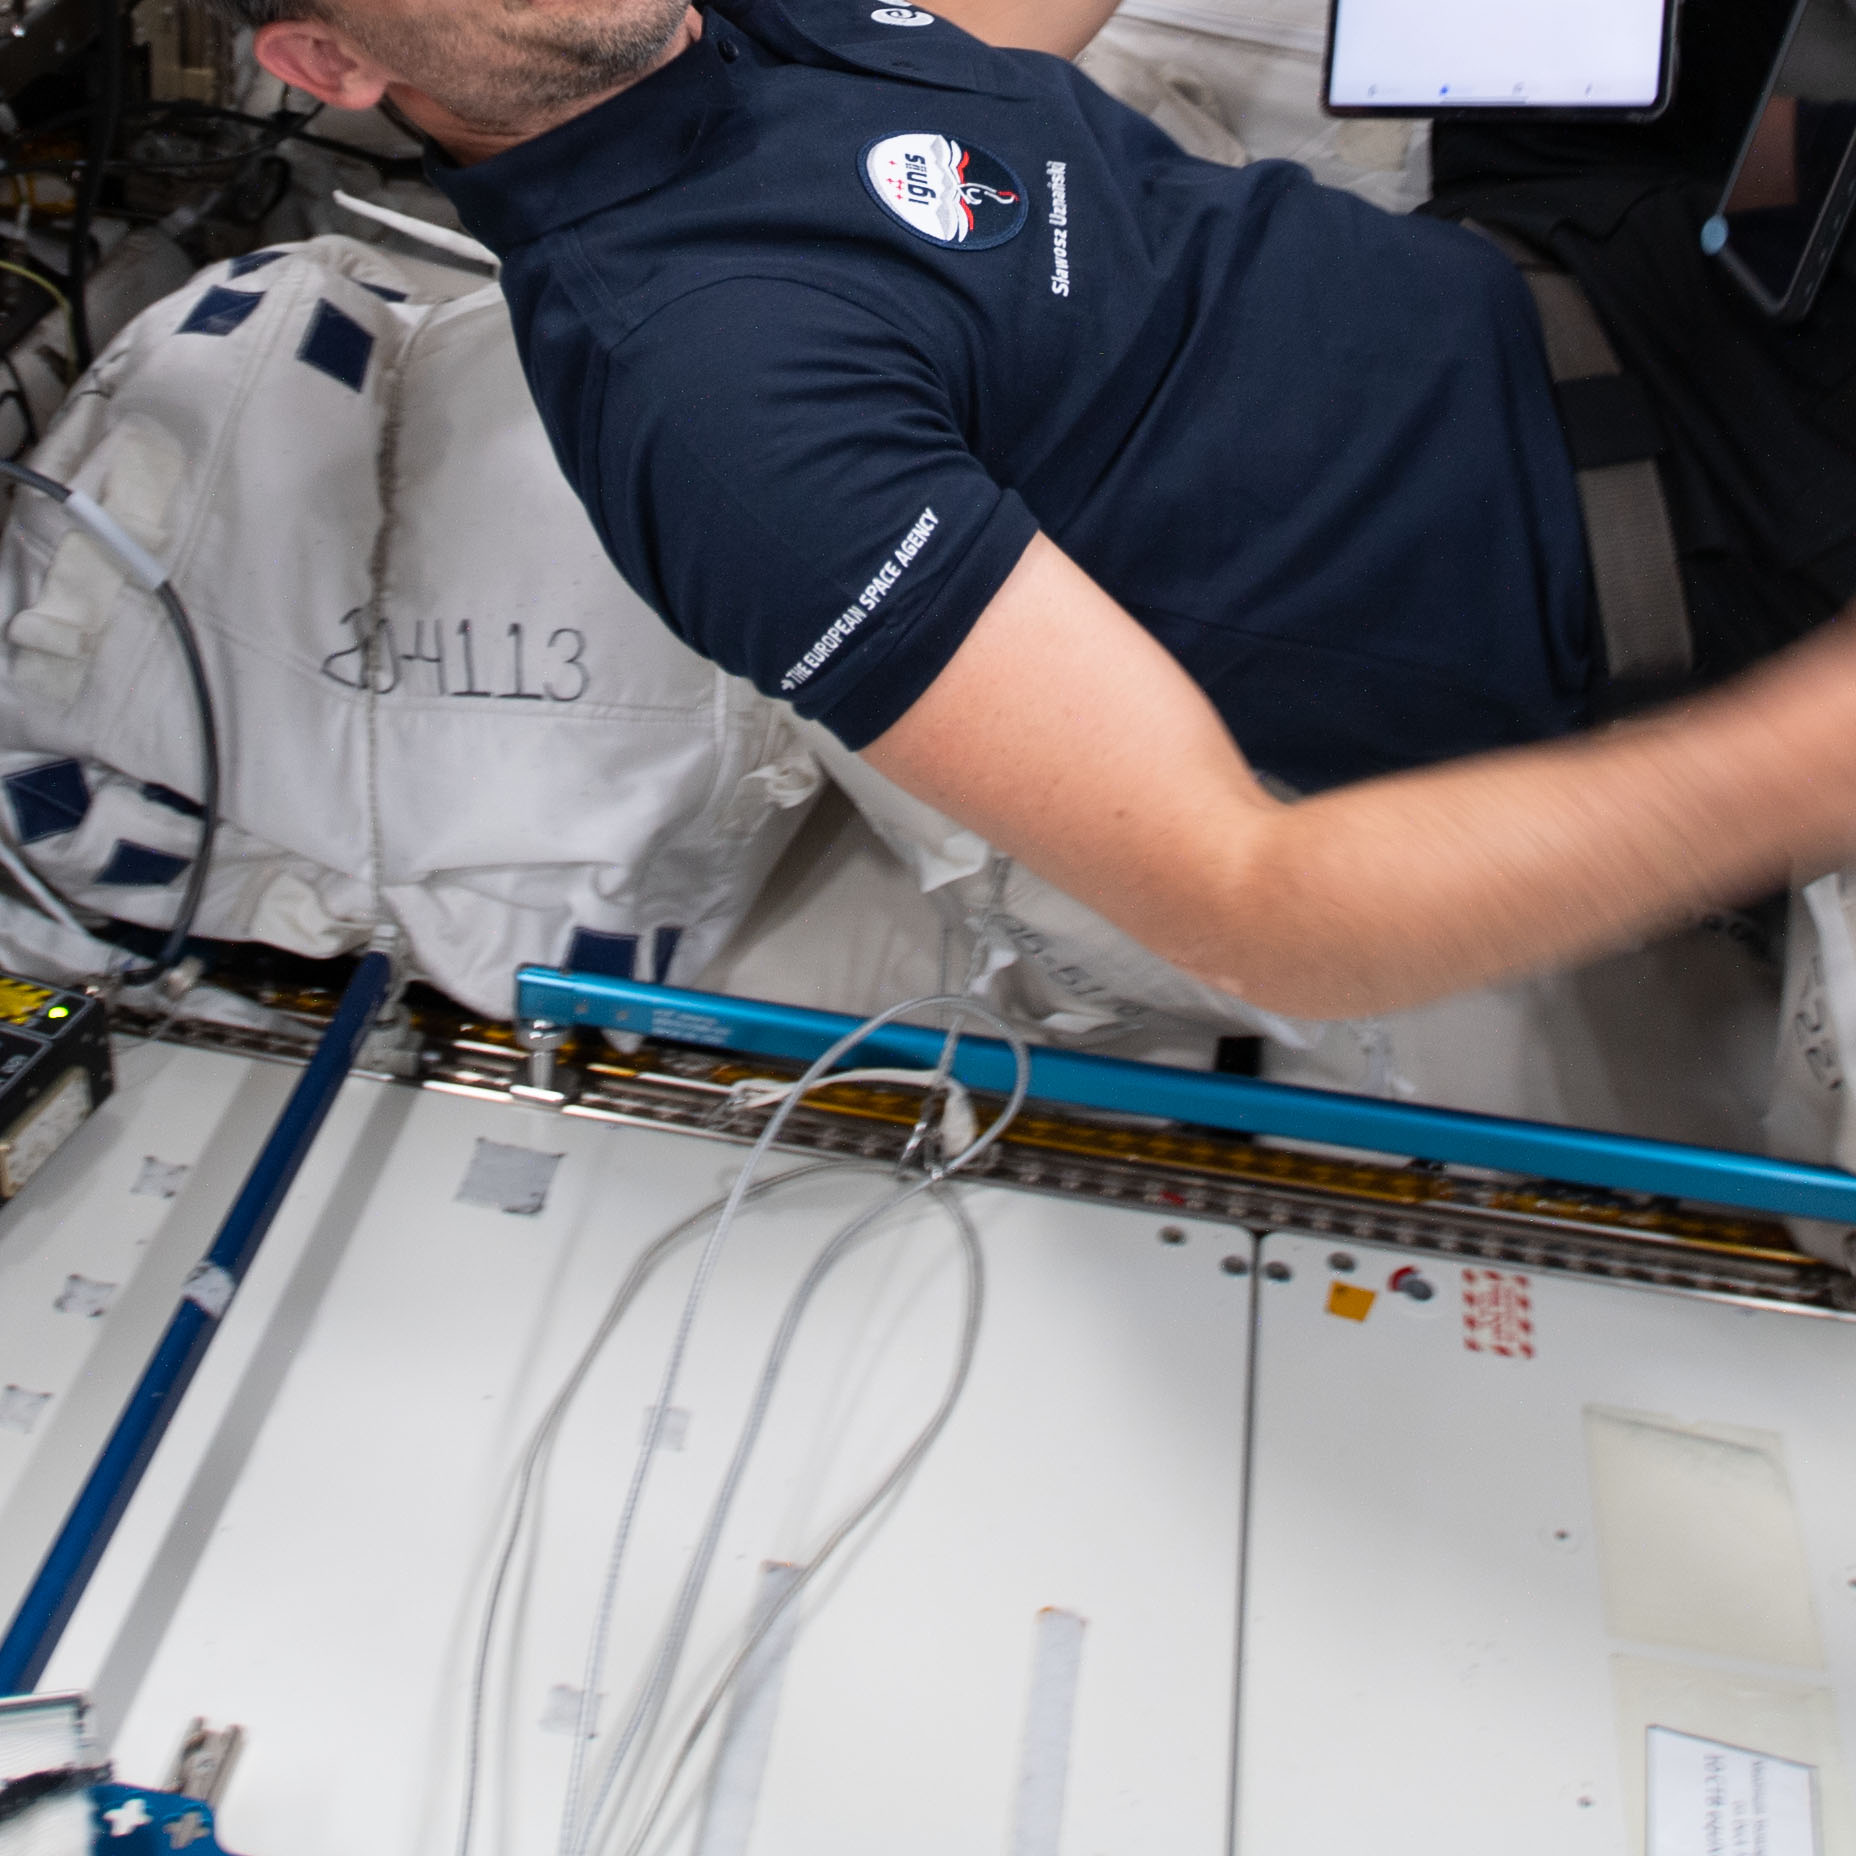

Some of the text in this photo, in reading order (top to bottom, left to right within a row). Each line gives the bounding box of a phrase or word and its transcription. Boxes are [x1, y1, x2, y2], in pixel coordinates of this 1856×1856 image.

[1050, 230, 1071, 297] Sławosz
[785, 506, 939, 686] THE EUROPEAN SPACE AGENCY
